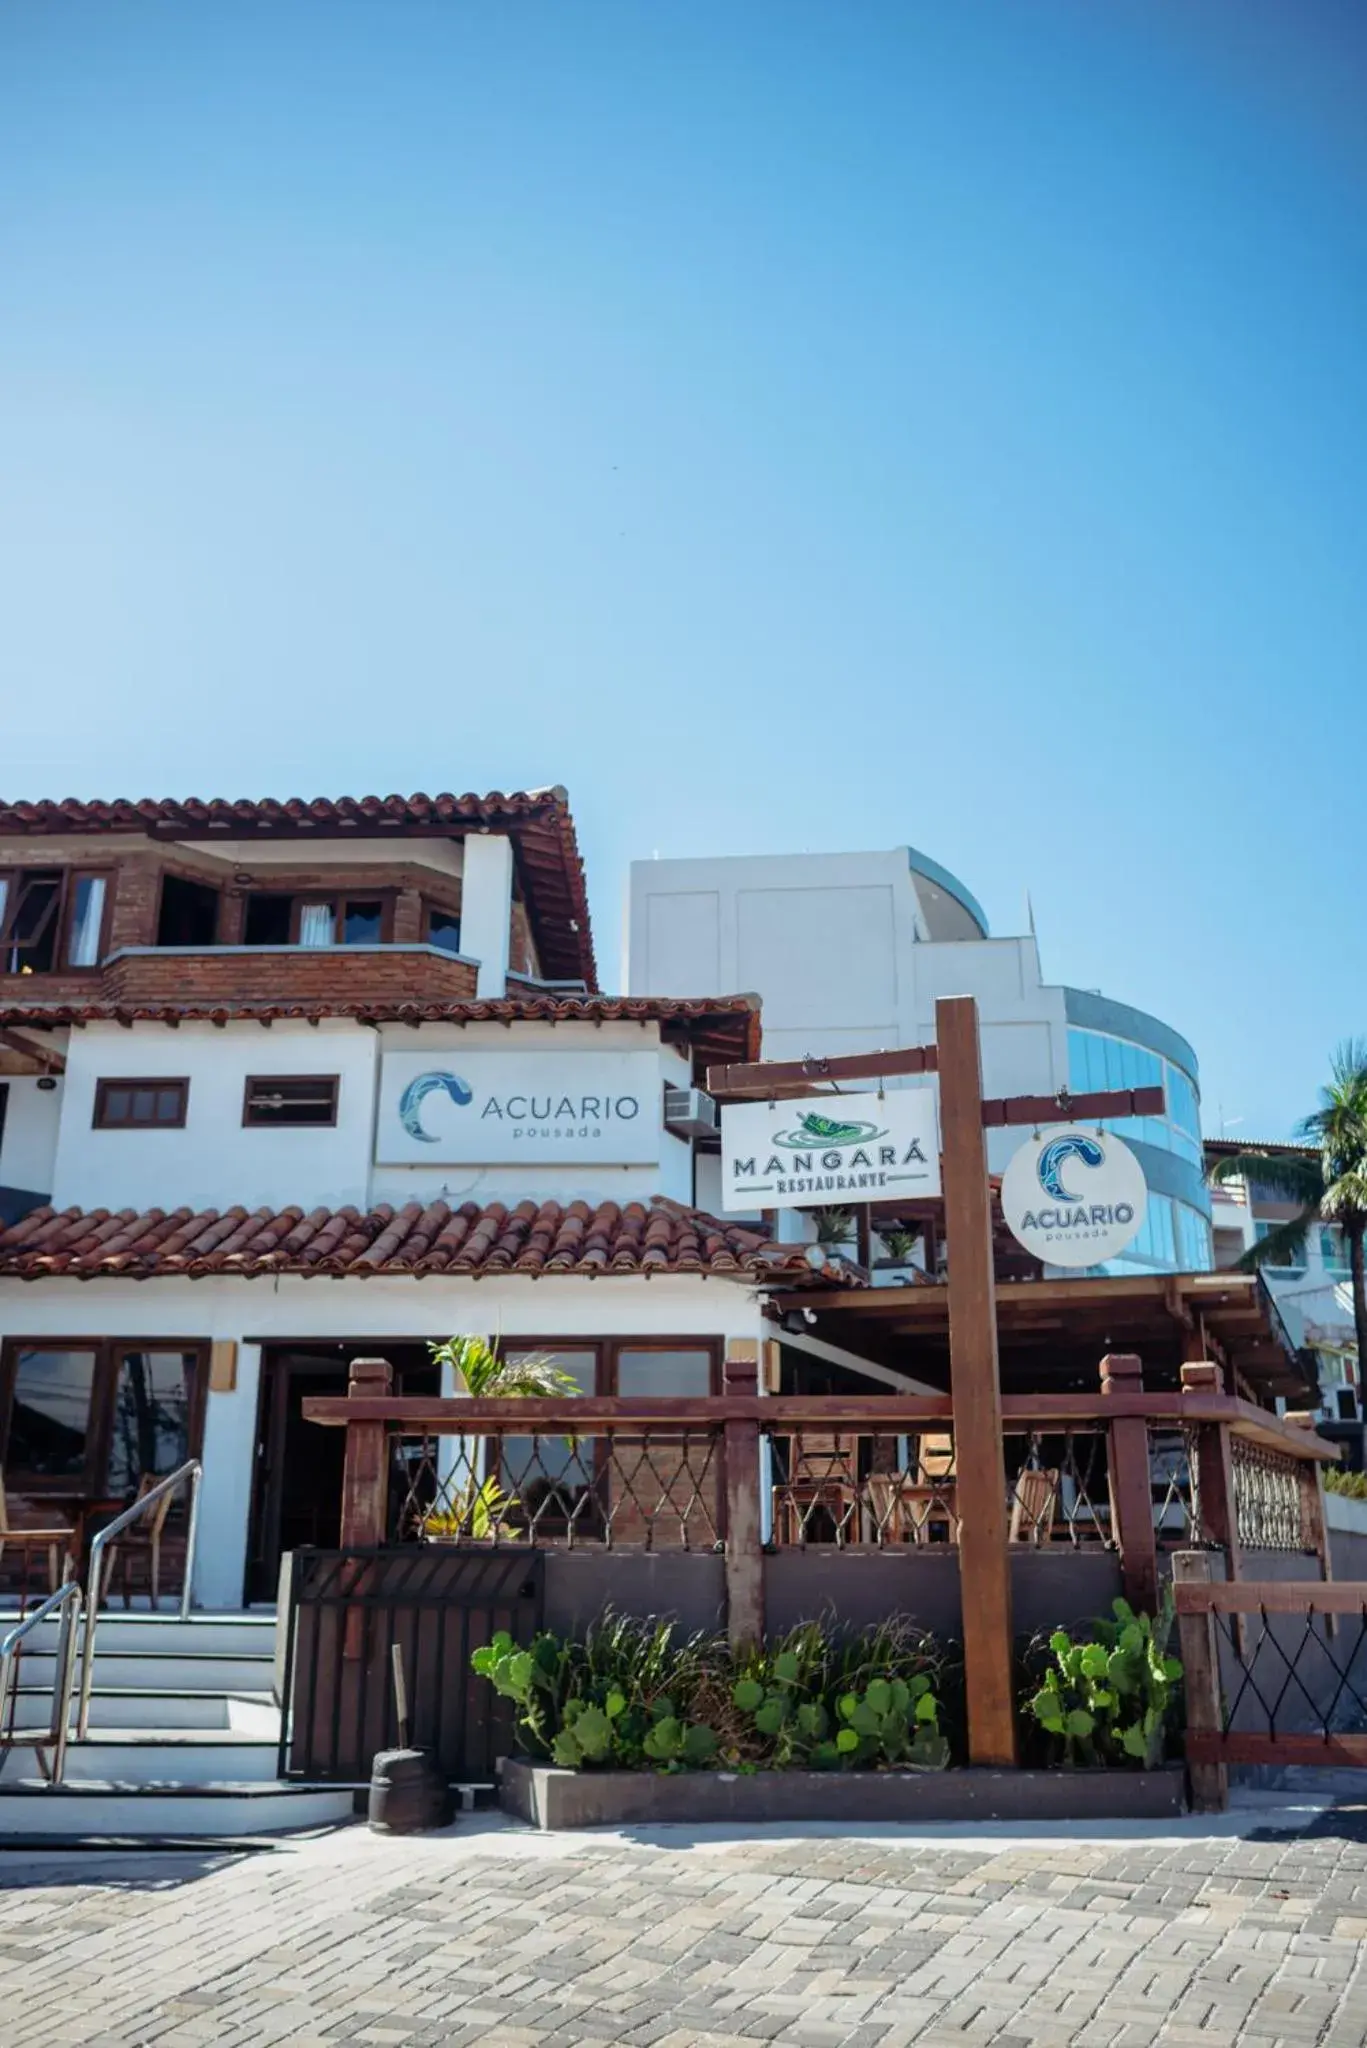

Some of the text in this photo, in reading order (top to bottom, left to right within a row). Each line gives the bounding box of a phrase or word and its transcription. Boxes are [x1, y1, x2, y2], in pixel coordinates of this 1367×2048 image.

[481, 1096, 639, 1120] ACUARIO
[512, 1125, 602, 1139] pousada
[733, 1137, 928, 1178] MANGARÁ
[776, 1172, 887, 1194] RESTAURANTE
[1021, 1203, 1134, 1231] ACUARIO
[1045, 1228, 1109, 1242] pousada
